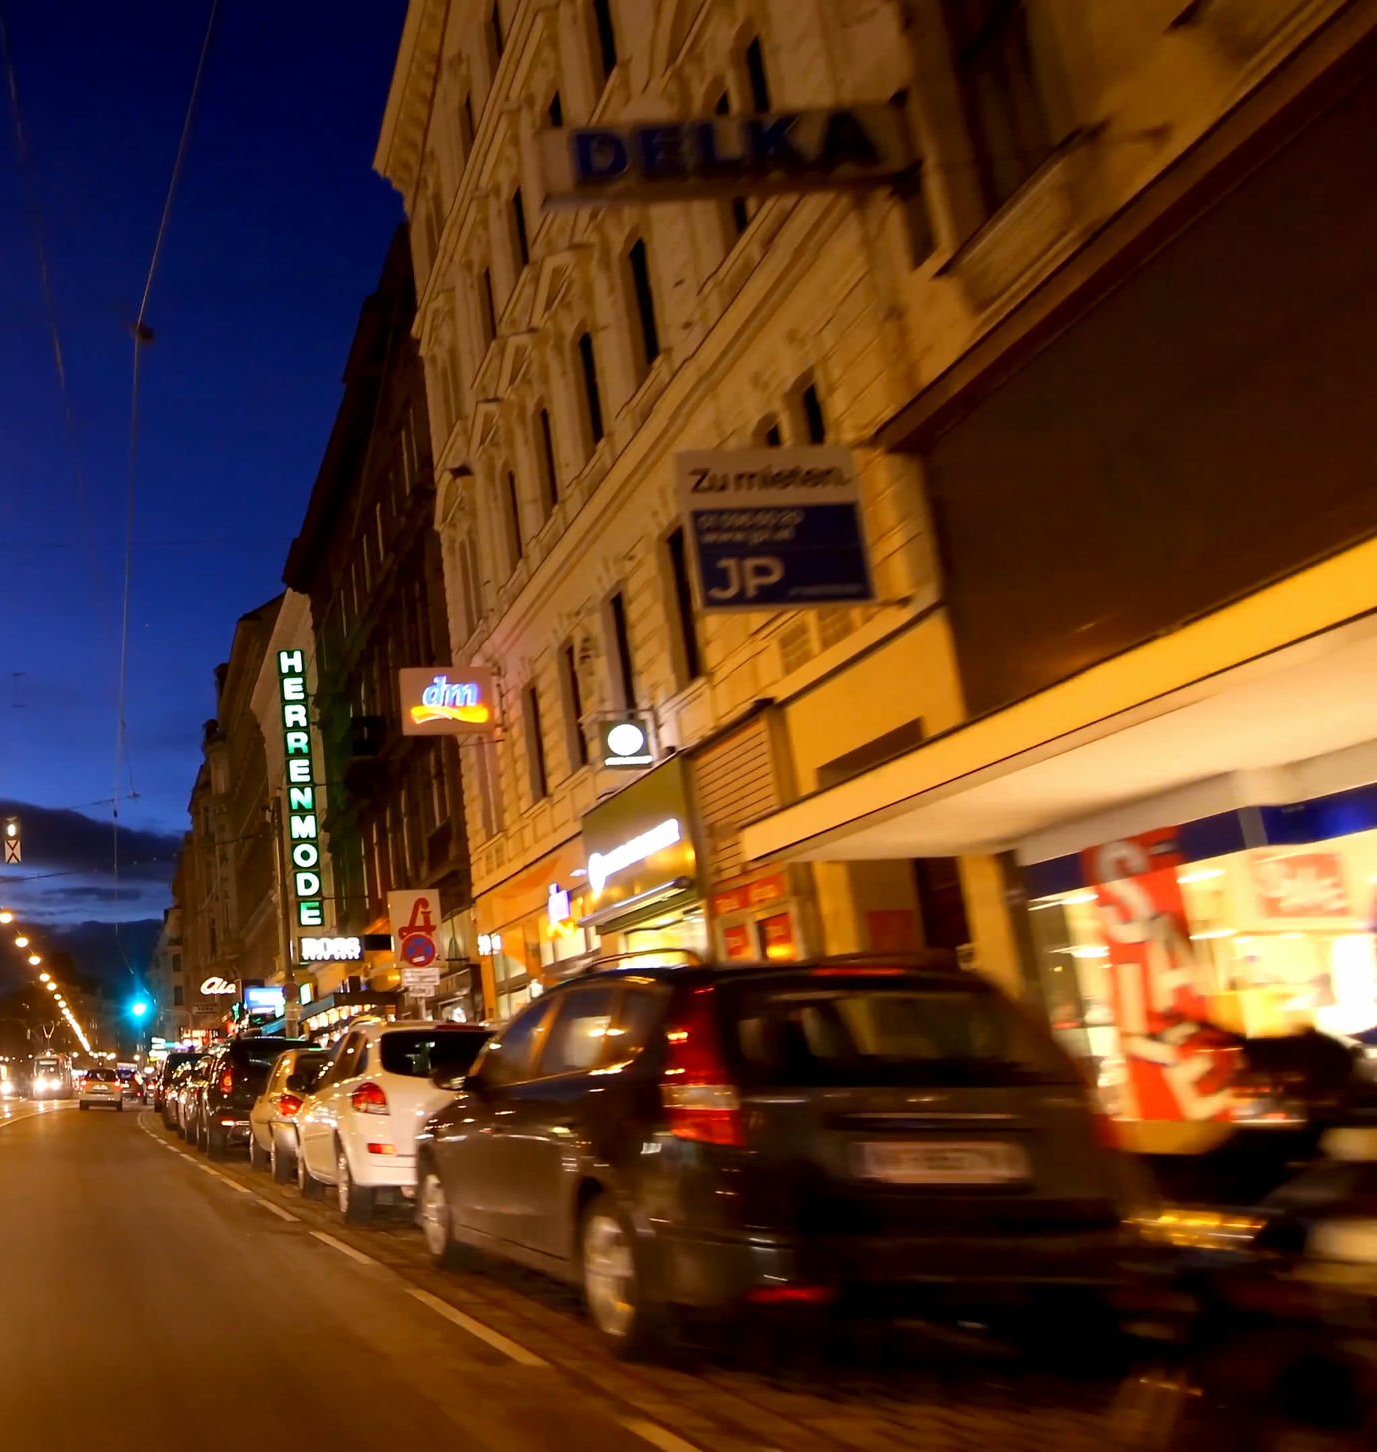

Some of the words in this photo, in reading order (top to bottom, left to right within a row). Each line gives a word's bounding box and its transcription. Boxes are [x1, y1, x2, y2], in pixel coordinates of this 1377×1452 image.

[572, 112, 883, 181] DELKA
[707, 557, 785, 599] JP
[422, 675, 480, 706] dm
[279, 651, 322, 926] HERRENMODE
